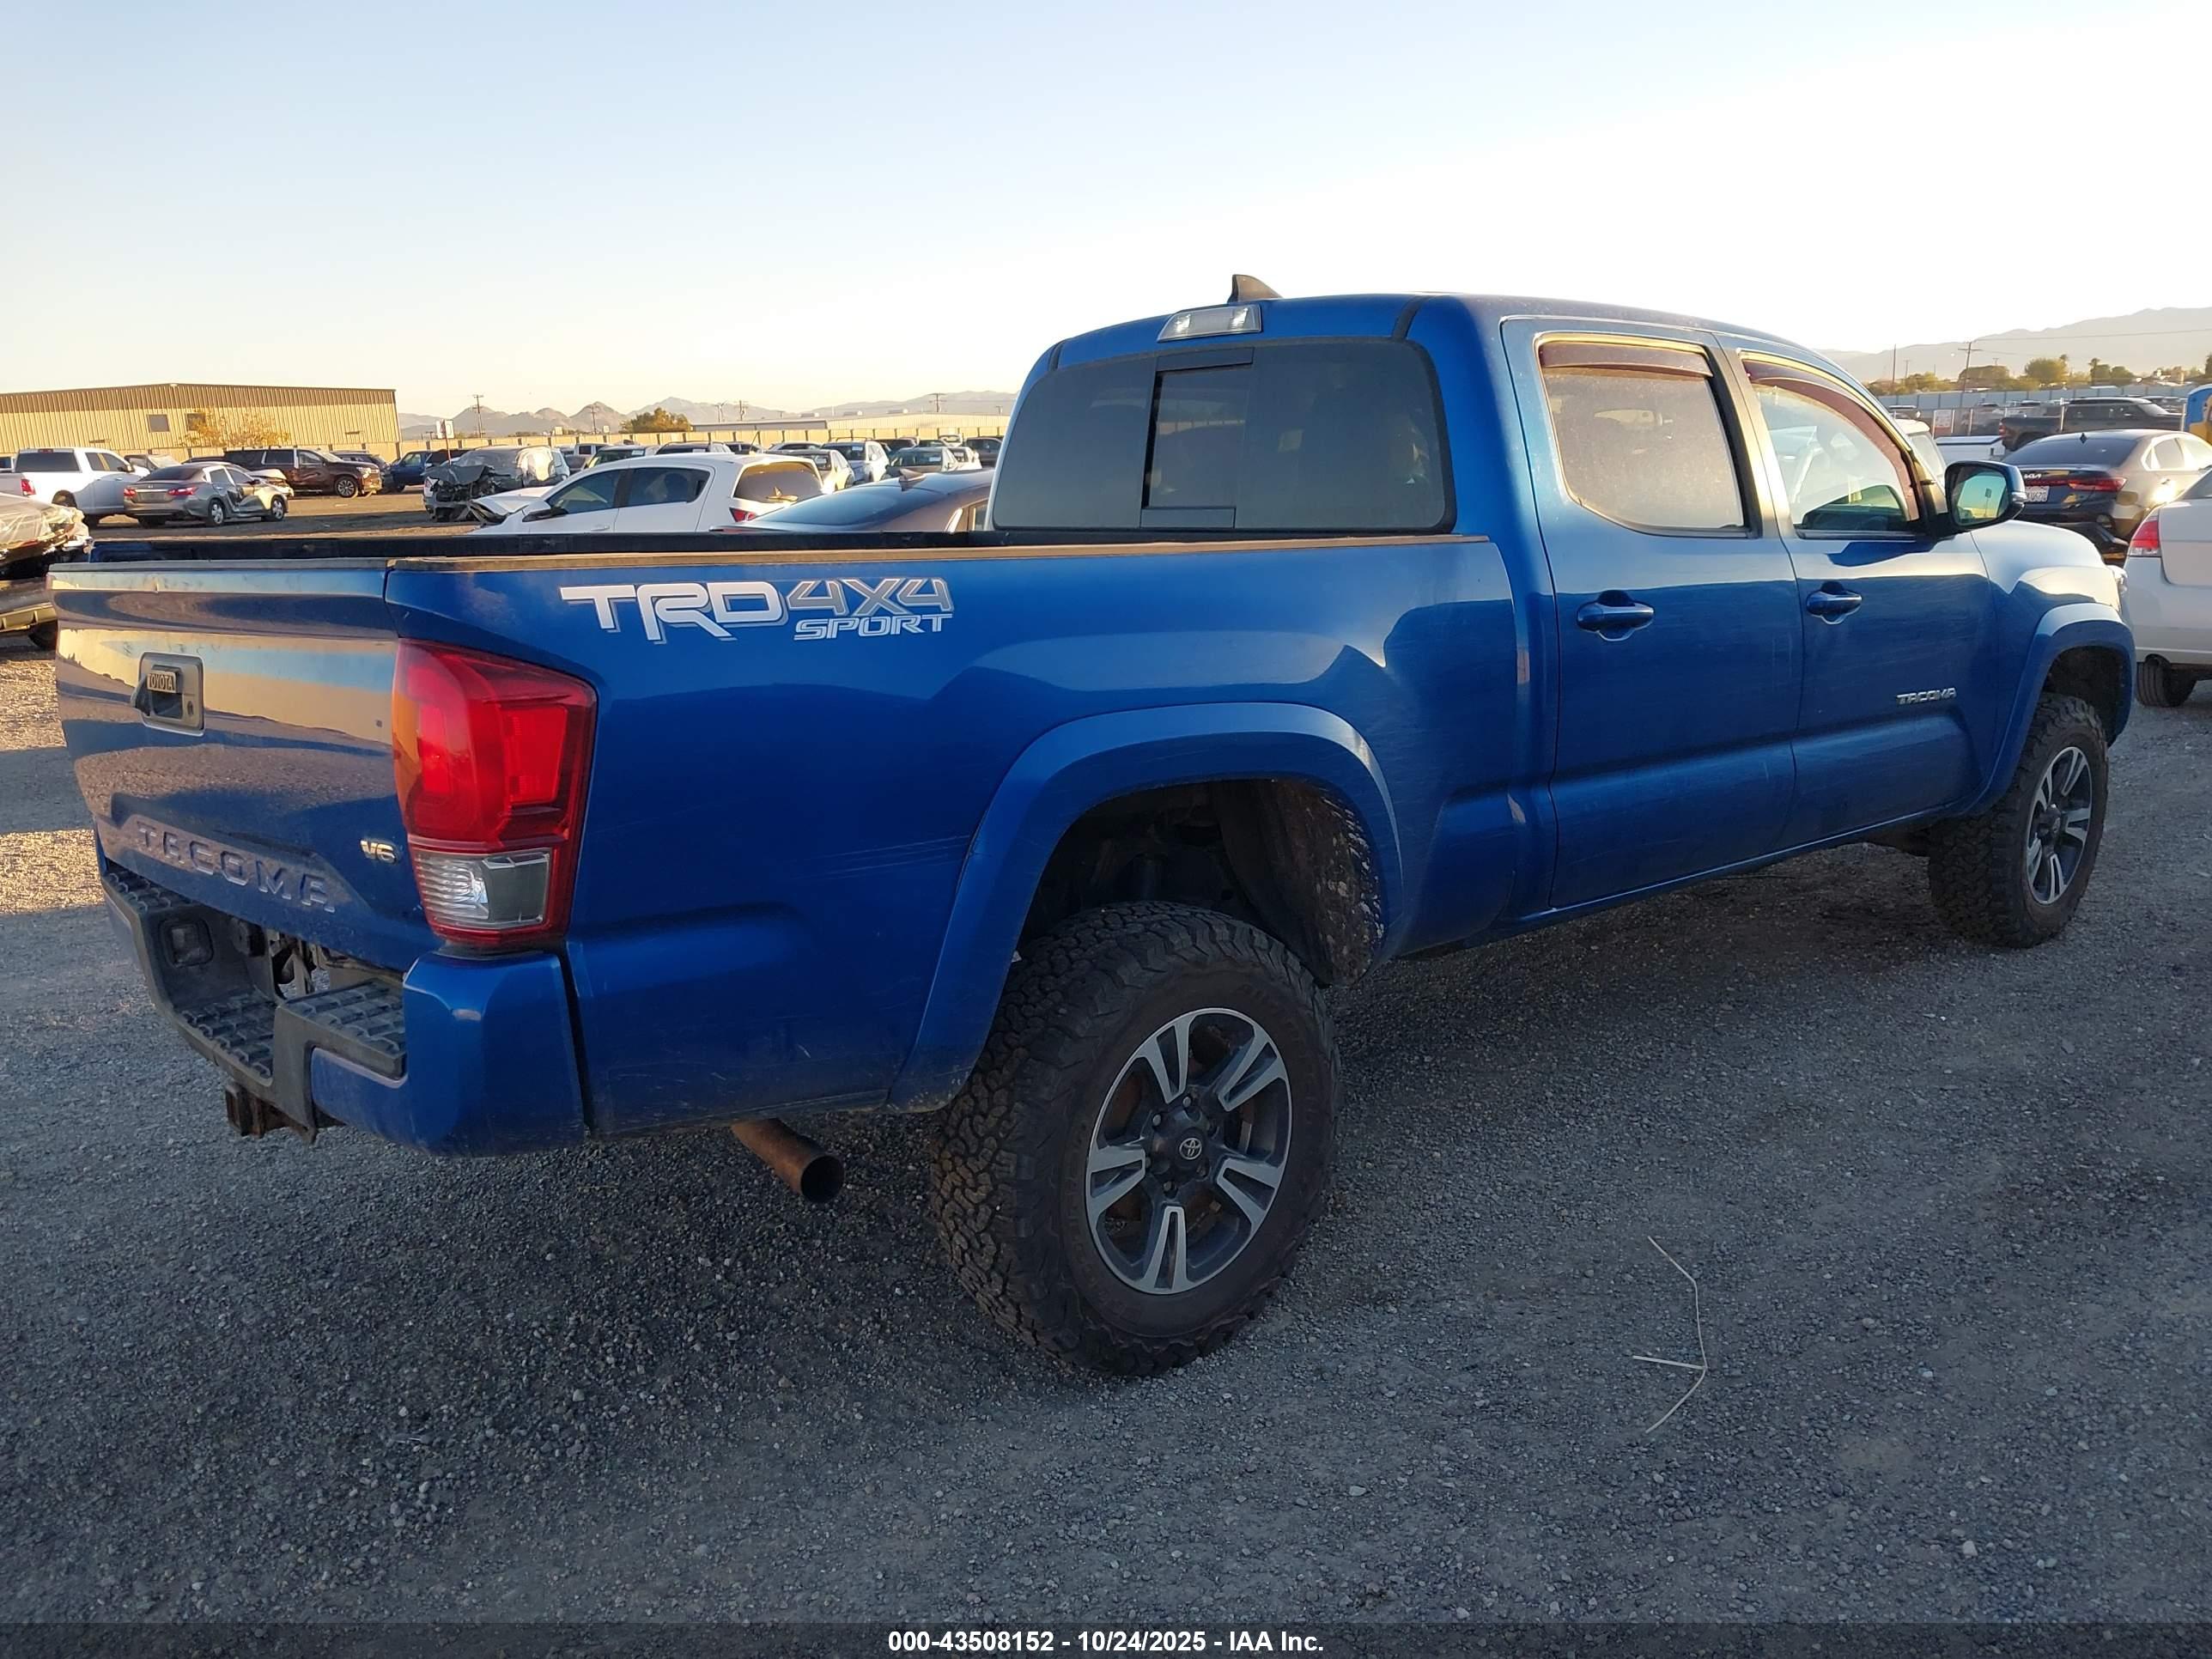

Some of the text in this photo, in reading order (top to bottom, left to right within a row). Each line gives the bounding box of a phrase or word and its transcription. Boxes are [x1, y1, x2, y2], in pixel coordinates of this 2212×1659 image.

[560, 577, 954, 644] TRD 4X4
[793, 613, 953, 641] SPORT
[147, 672, 176, 691] TOYOTA
[1896, 687, 1957, 705] TACOMA
[360, 839, 397, 864] V6
[136, 820, 336, 913] TACOMA
